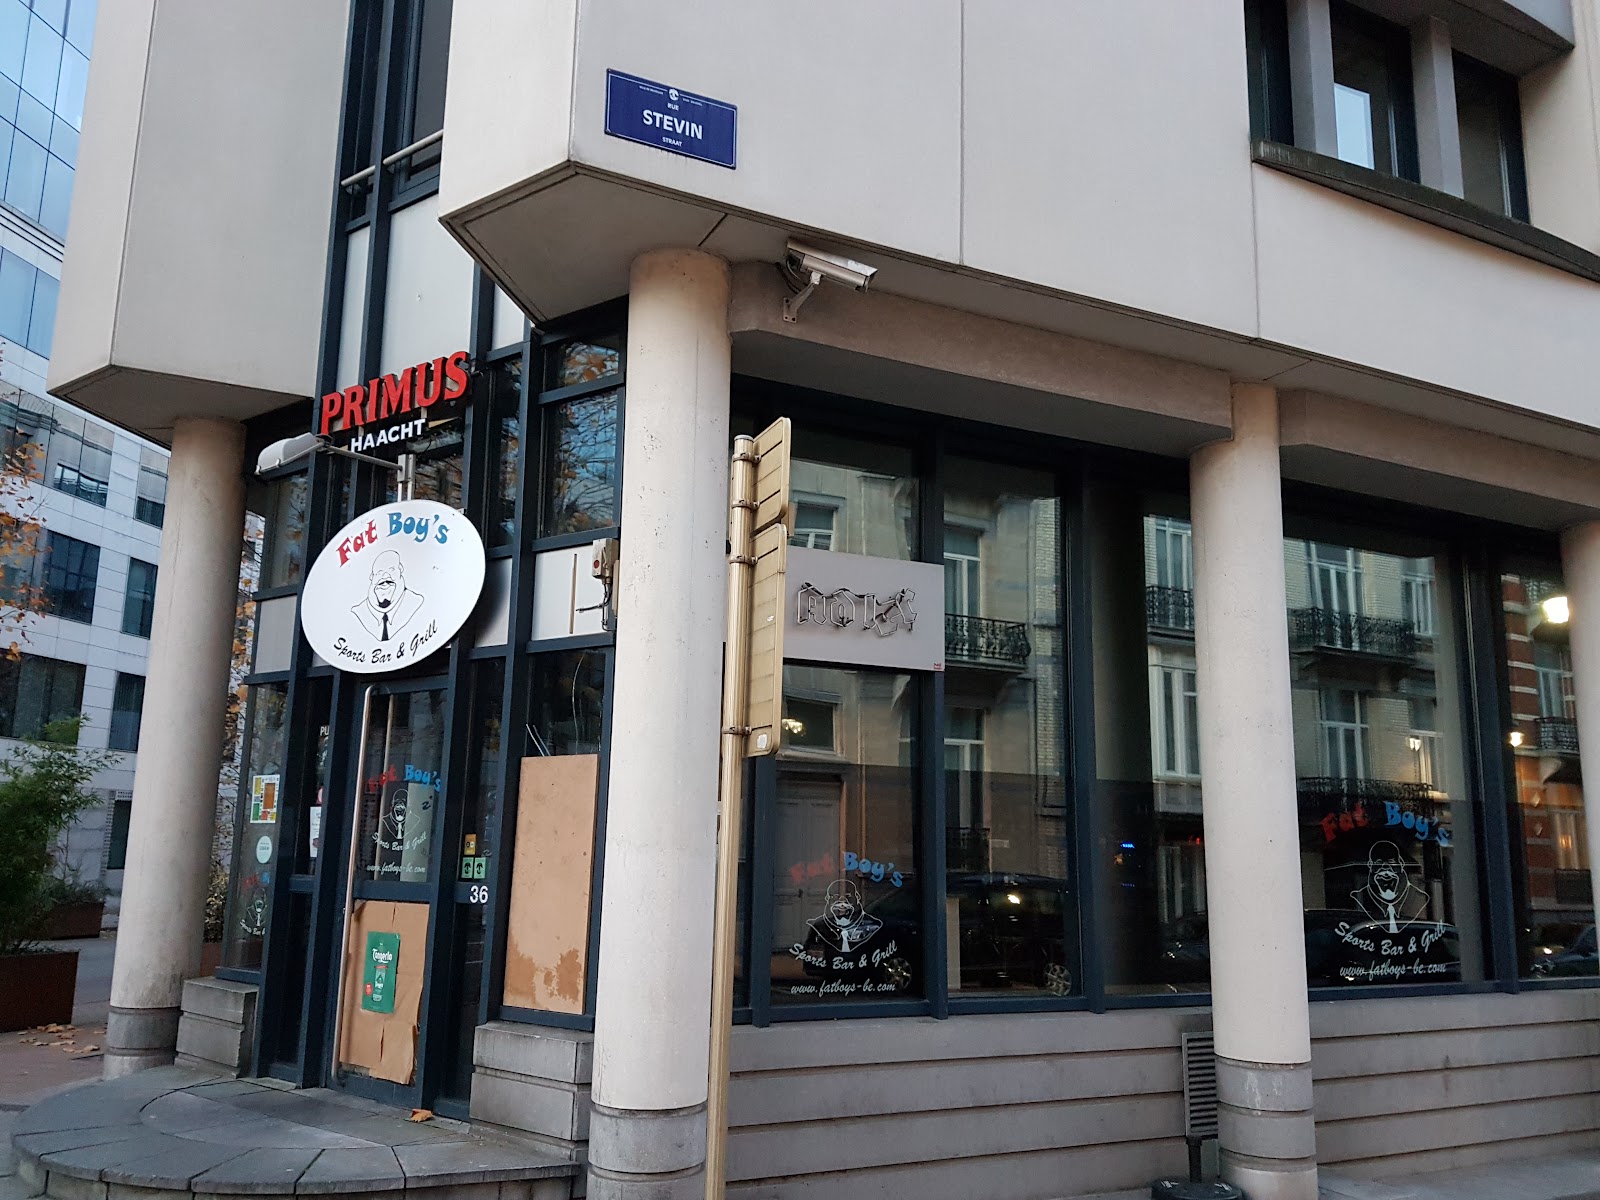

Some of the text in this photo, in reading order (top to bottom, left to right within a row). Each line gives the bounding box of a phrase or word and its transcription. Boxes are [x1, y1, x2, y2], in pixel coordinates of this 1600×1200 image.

[667, 102, 680, 111] RUE
[642, 109, 703, 140] STEVIN
[662, 136, 683, 147] STRAAT
[320, 351, 470, 435] PRIMUS
[351, 418, 426, 452] HAACHT
[335, 512, 450, 568] Fat Boy's
[333, 619, 438, 664] Sports Bar & Grill
[404, 764, 441, 792] Boy's
[1320, 800, 1454, 848] Fat Boy's
[840, 851, 904, 888] Boy's
[469, 884, 489, 904] 36
[1334, 919, 1446, 955] Sports Bar & Grill
[788, 939, 898, 970] Sports Bar & Grill
[1339, 958, 1447, 981] www.fatboys-be.com
[790, 978, 896, 998] www.fatboys-be.com
